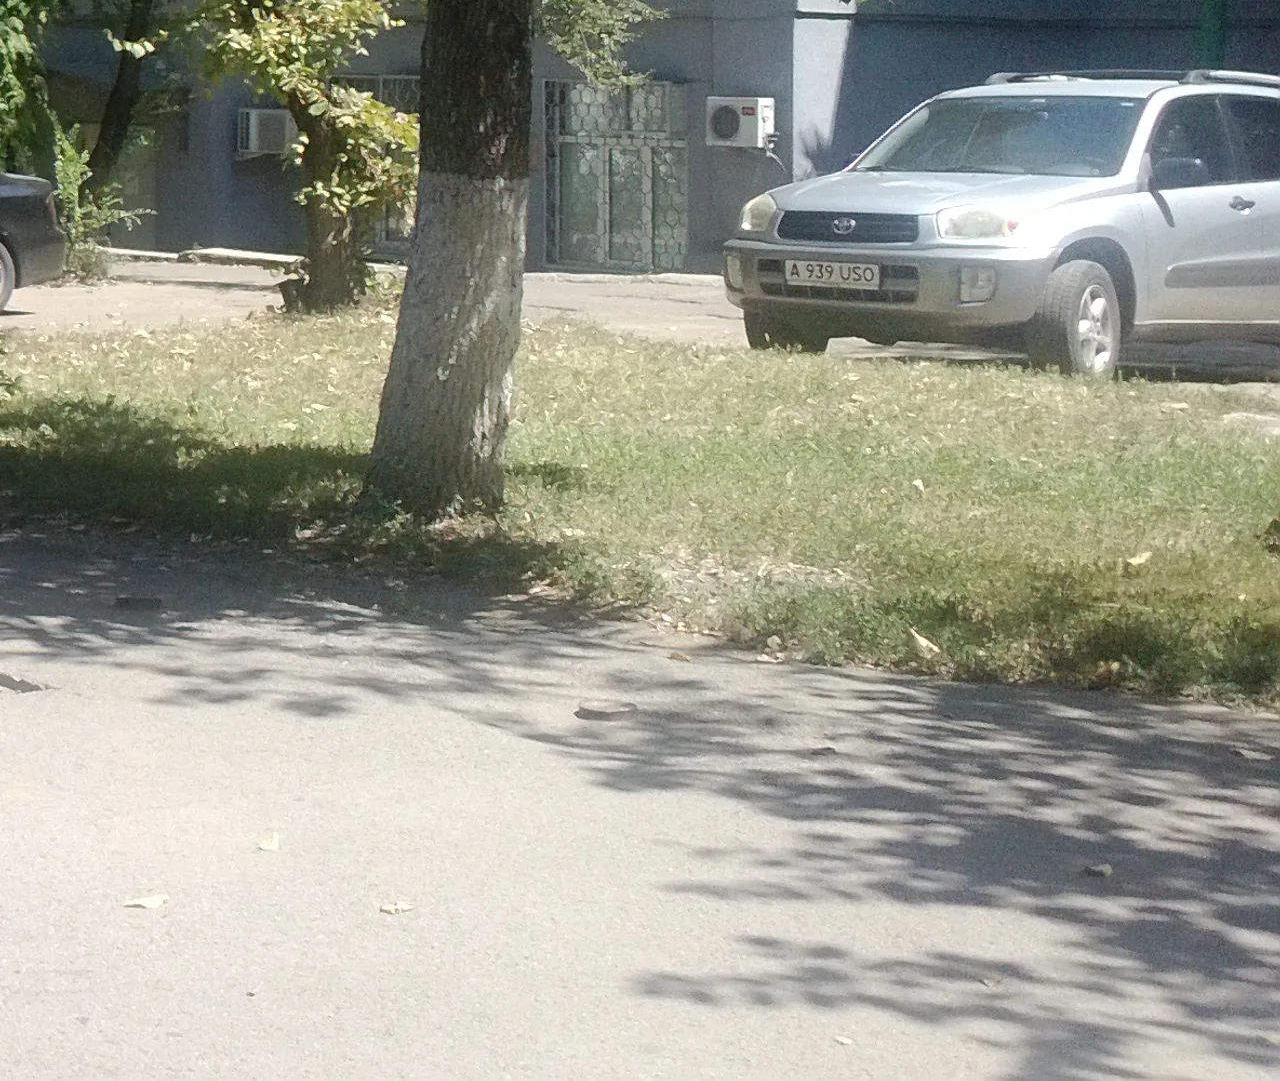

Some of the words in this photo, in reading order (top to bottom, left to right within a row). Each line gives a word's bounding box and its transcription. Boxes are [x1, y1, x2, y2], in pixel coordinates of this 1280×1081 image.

[790, 262, 800, 278] A
[805, 263, 834, 280] 939
[839, 265, 875, 283] USO
